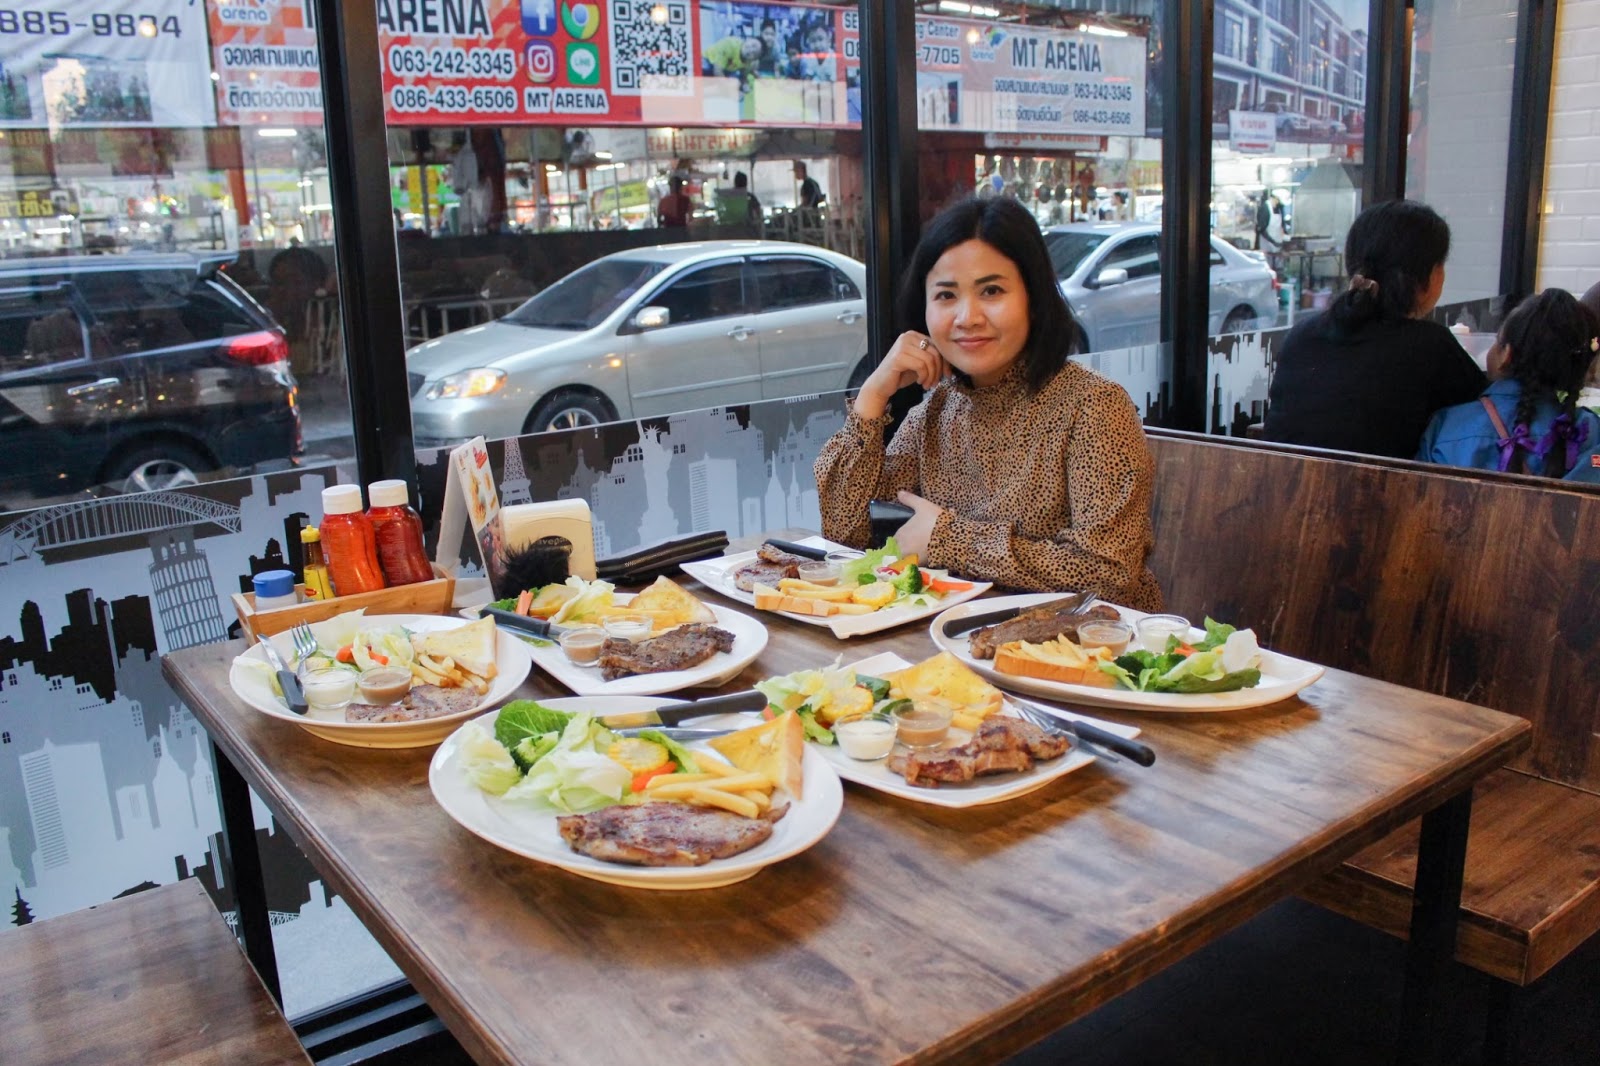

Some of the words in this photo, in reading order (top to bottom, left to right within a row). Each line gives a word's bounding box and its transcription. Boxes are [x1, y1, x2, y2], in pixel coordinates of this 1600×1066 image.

[221, 8, 268, 21] arena
[378, 0, 490, 35] ARENA
[928, 20, 959, 38] Center
[391, 48, 514, 75] 063-242-3345
[916, 46, 960, 65] -7705
[1012, 36, 1038, 68] MT
[1044, 39, 1102, 73] ARENA
[394, 88, 516, 109] 086-433-6506
[527, 92, 549, 108] MT
[555, 93, 606, 109] ARENA
[1073, 82, 1132, 101] 063-242-3345
[1073, 109, 1132, 125] 086-433-6506
